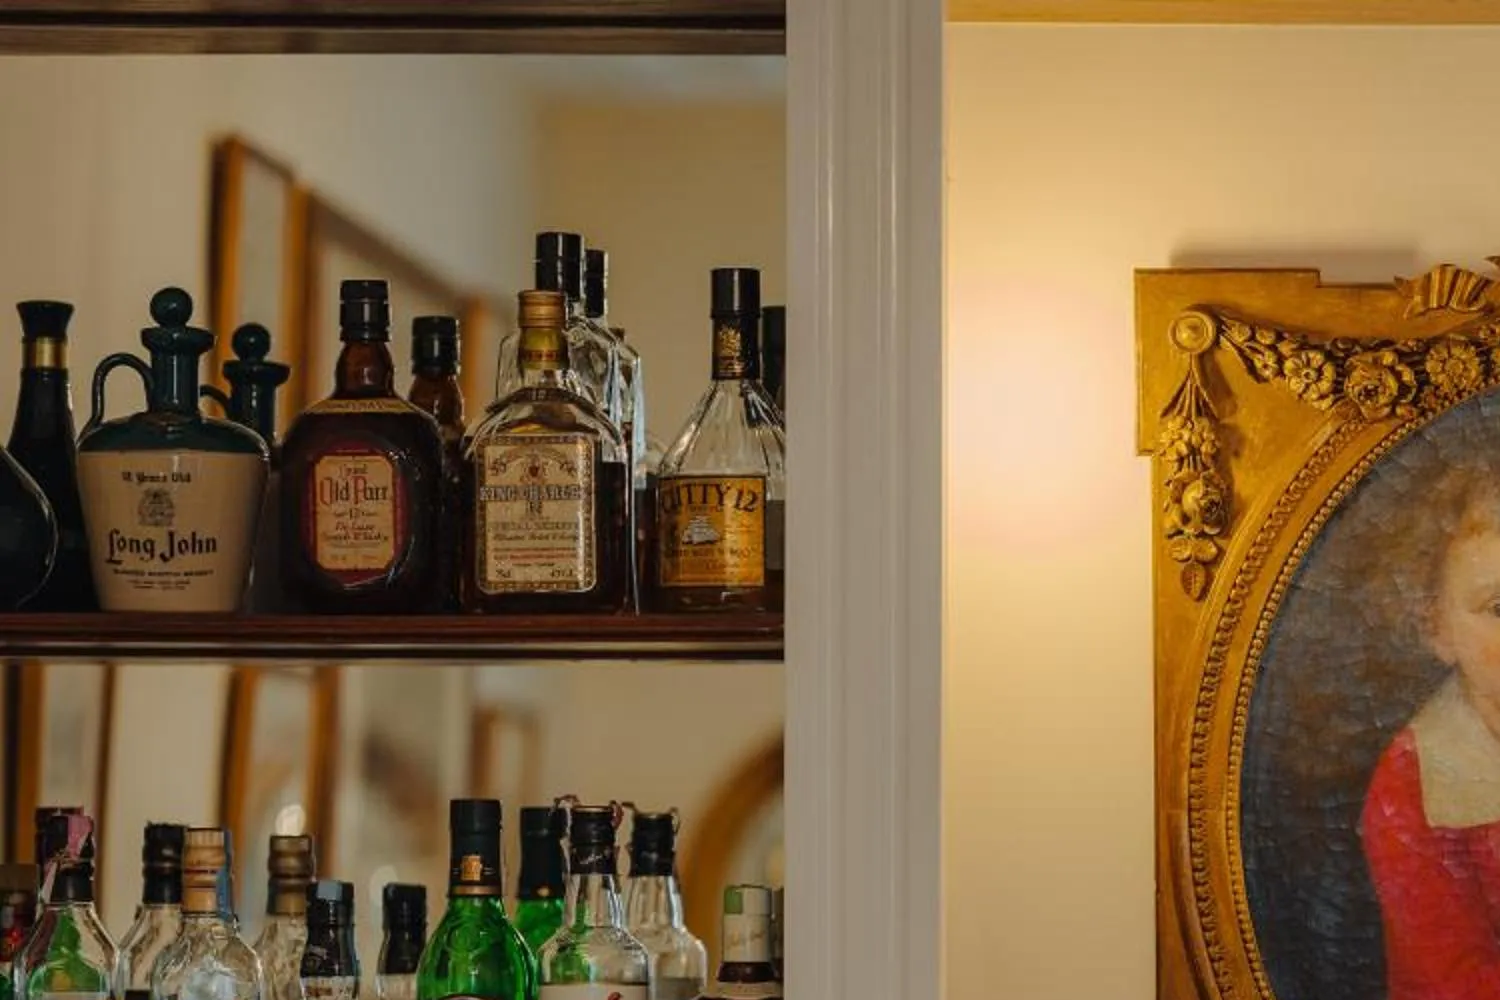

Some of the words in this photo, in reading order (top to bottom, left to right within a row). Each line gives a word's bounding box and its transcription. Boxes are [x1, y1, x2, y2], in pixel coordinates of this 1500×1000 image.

[319, 477, 349, 506] Old
[351, 476, 389, 505] Parr
[661, 482, 732, 514] CUTTY
[733, 488, 759, 512] 12
[105, 528, 157, 565] Long
[159, 531, 218, 562] John
